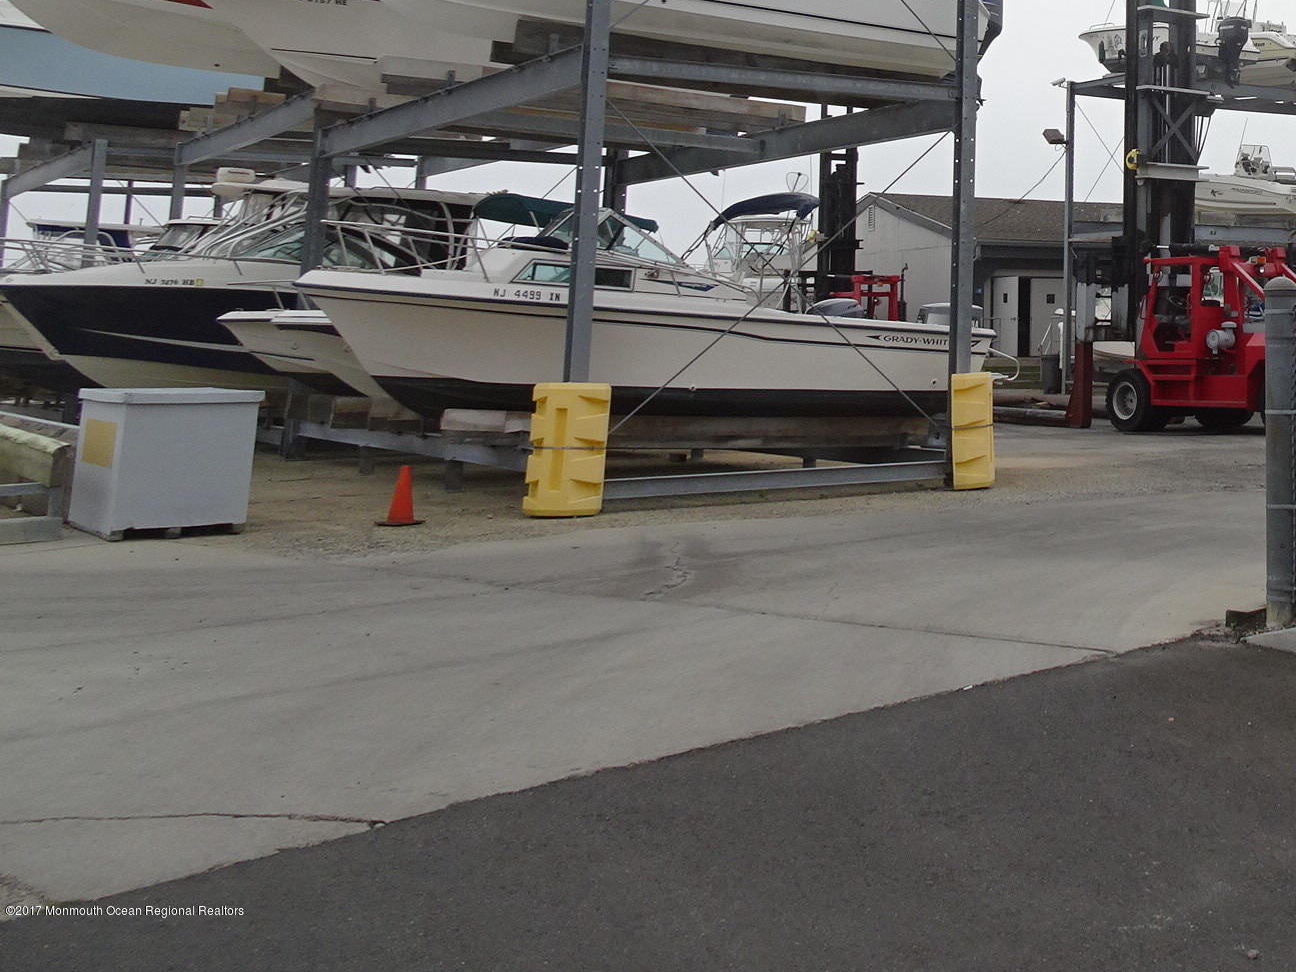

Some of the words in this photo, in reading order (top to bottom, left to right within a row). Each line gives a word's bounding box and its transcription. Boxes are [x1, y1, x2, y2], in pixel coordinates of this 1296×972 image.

[493, 288, 506, 298] NJ
[514, 289, 542, 301] 4499
[883, 334, 949, 346] GRADY-WHIT
